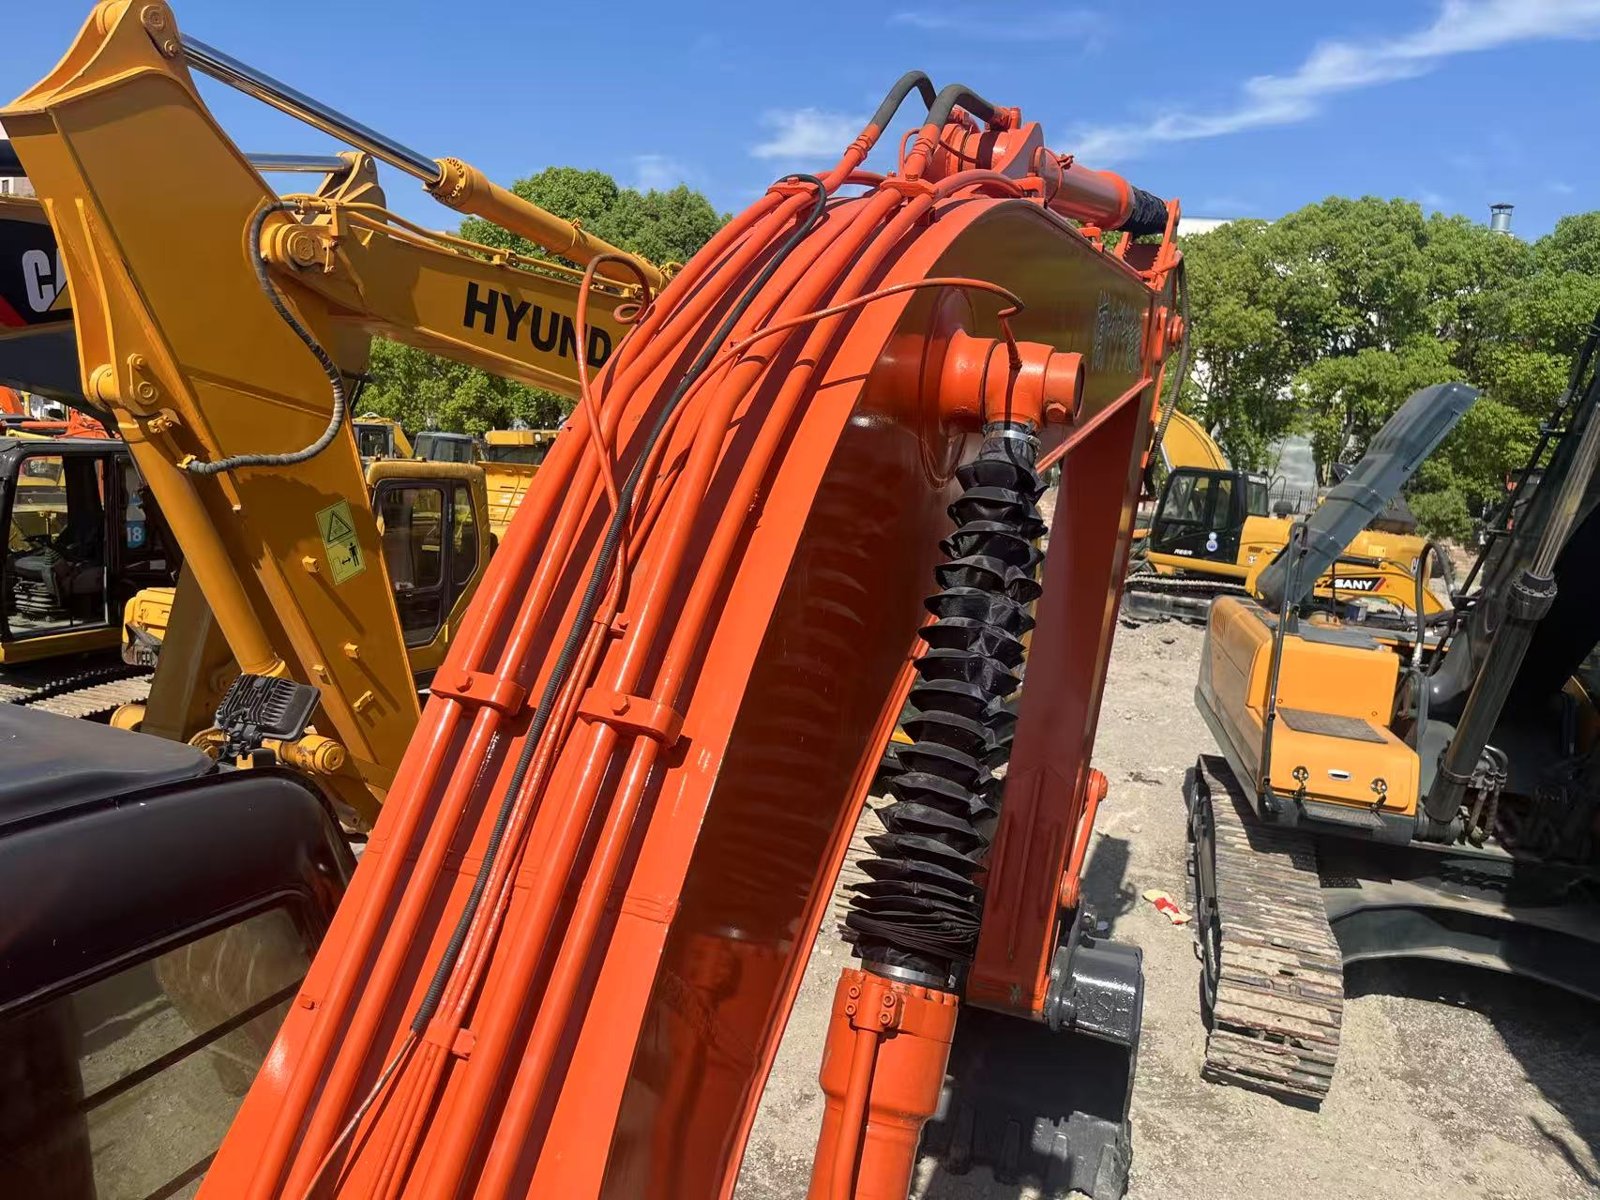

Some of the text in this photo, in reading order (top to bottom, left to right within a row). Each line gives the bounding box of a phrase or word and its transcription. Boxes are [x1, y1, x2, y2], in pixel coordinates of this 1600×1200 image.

[463, 281, 622, 369] HYUND
[126, 526, 142, 542] 18
[1334, 578, 1373, 590] SANY
